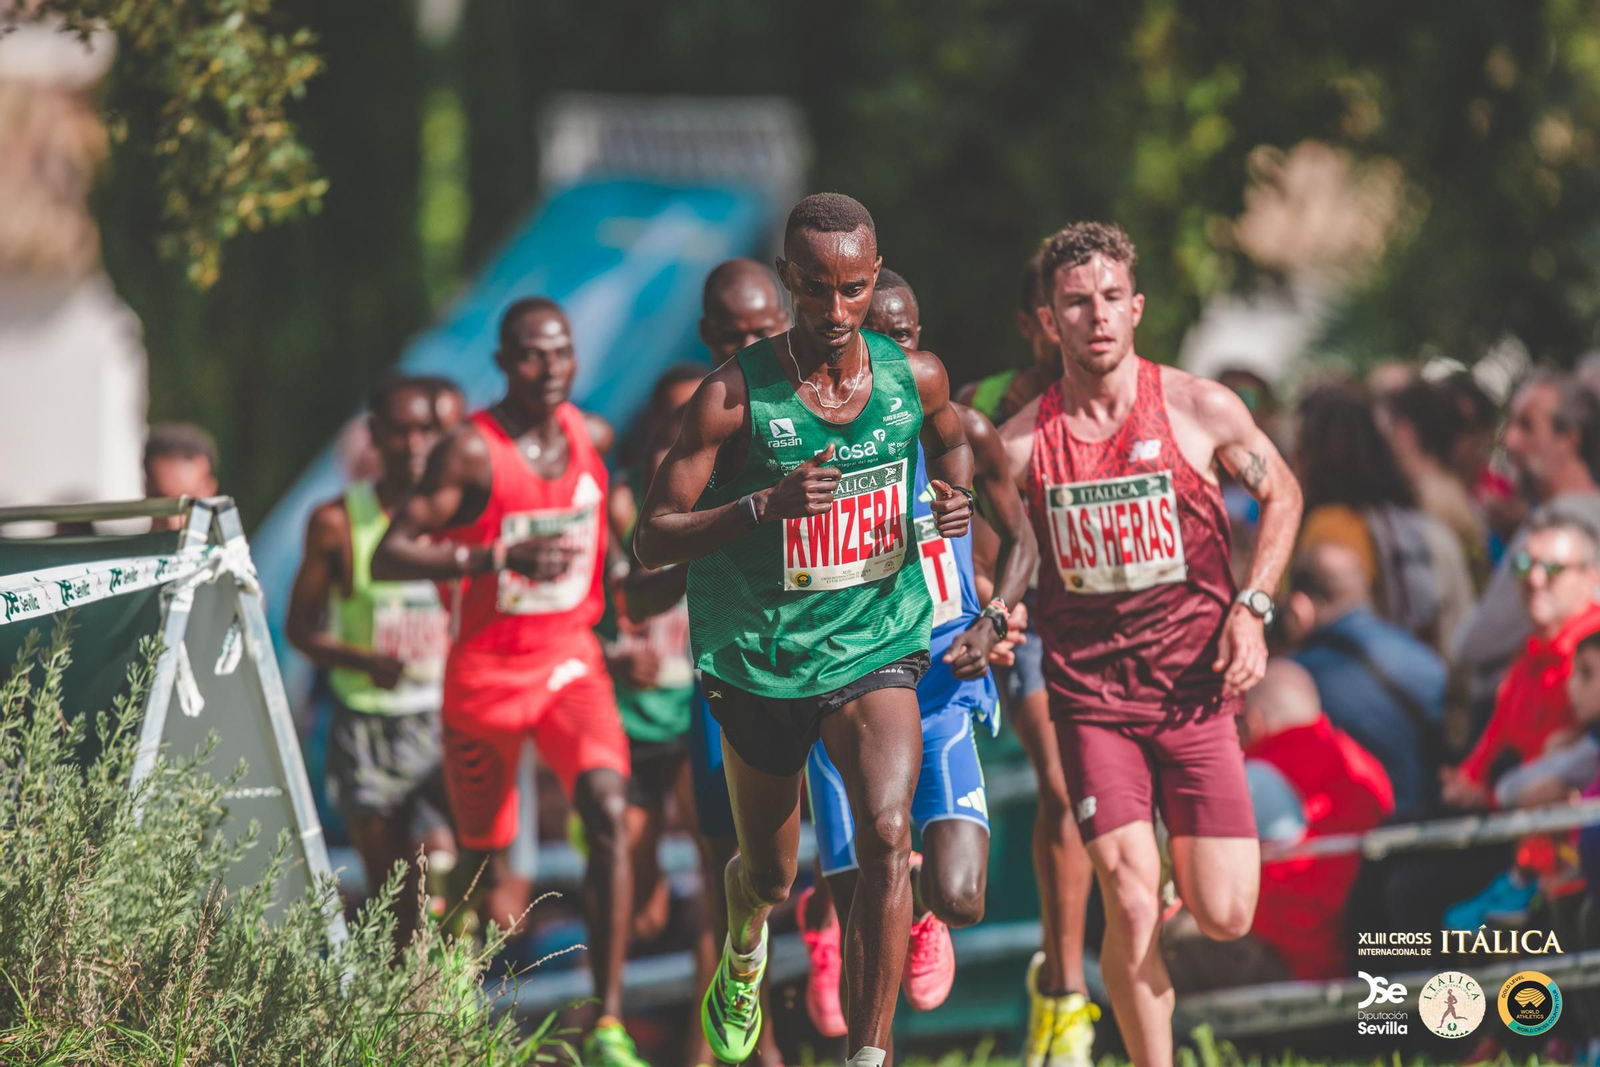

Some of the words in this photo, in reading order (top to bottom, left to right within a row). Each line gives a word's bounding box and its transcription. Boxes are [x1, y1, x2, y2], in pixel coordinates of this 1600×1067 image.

[768, 437, 803, 448] rasán
[787, 484, 904, 569] KWIZERA
[1052, 507, 1097, 570] LAS
[1099, 498, 1175, 566] HERAS
